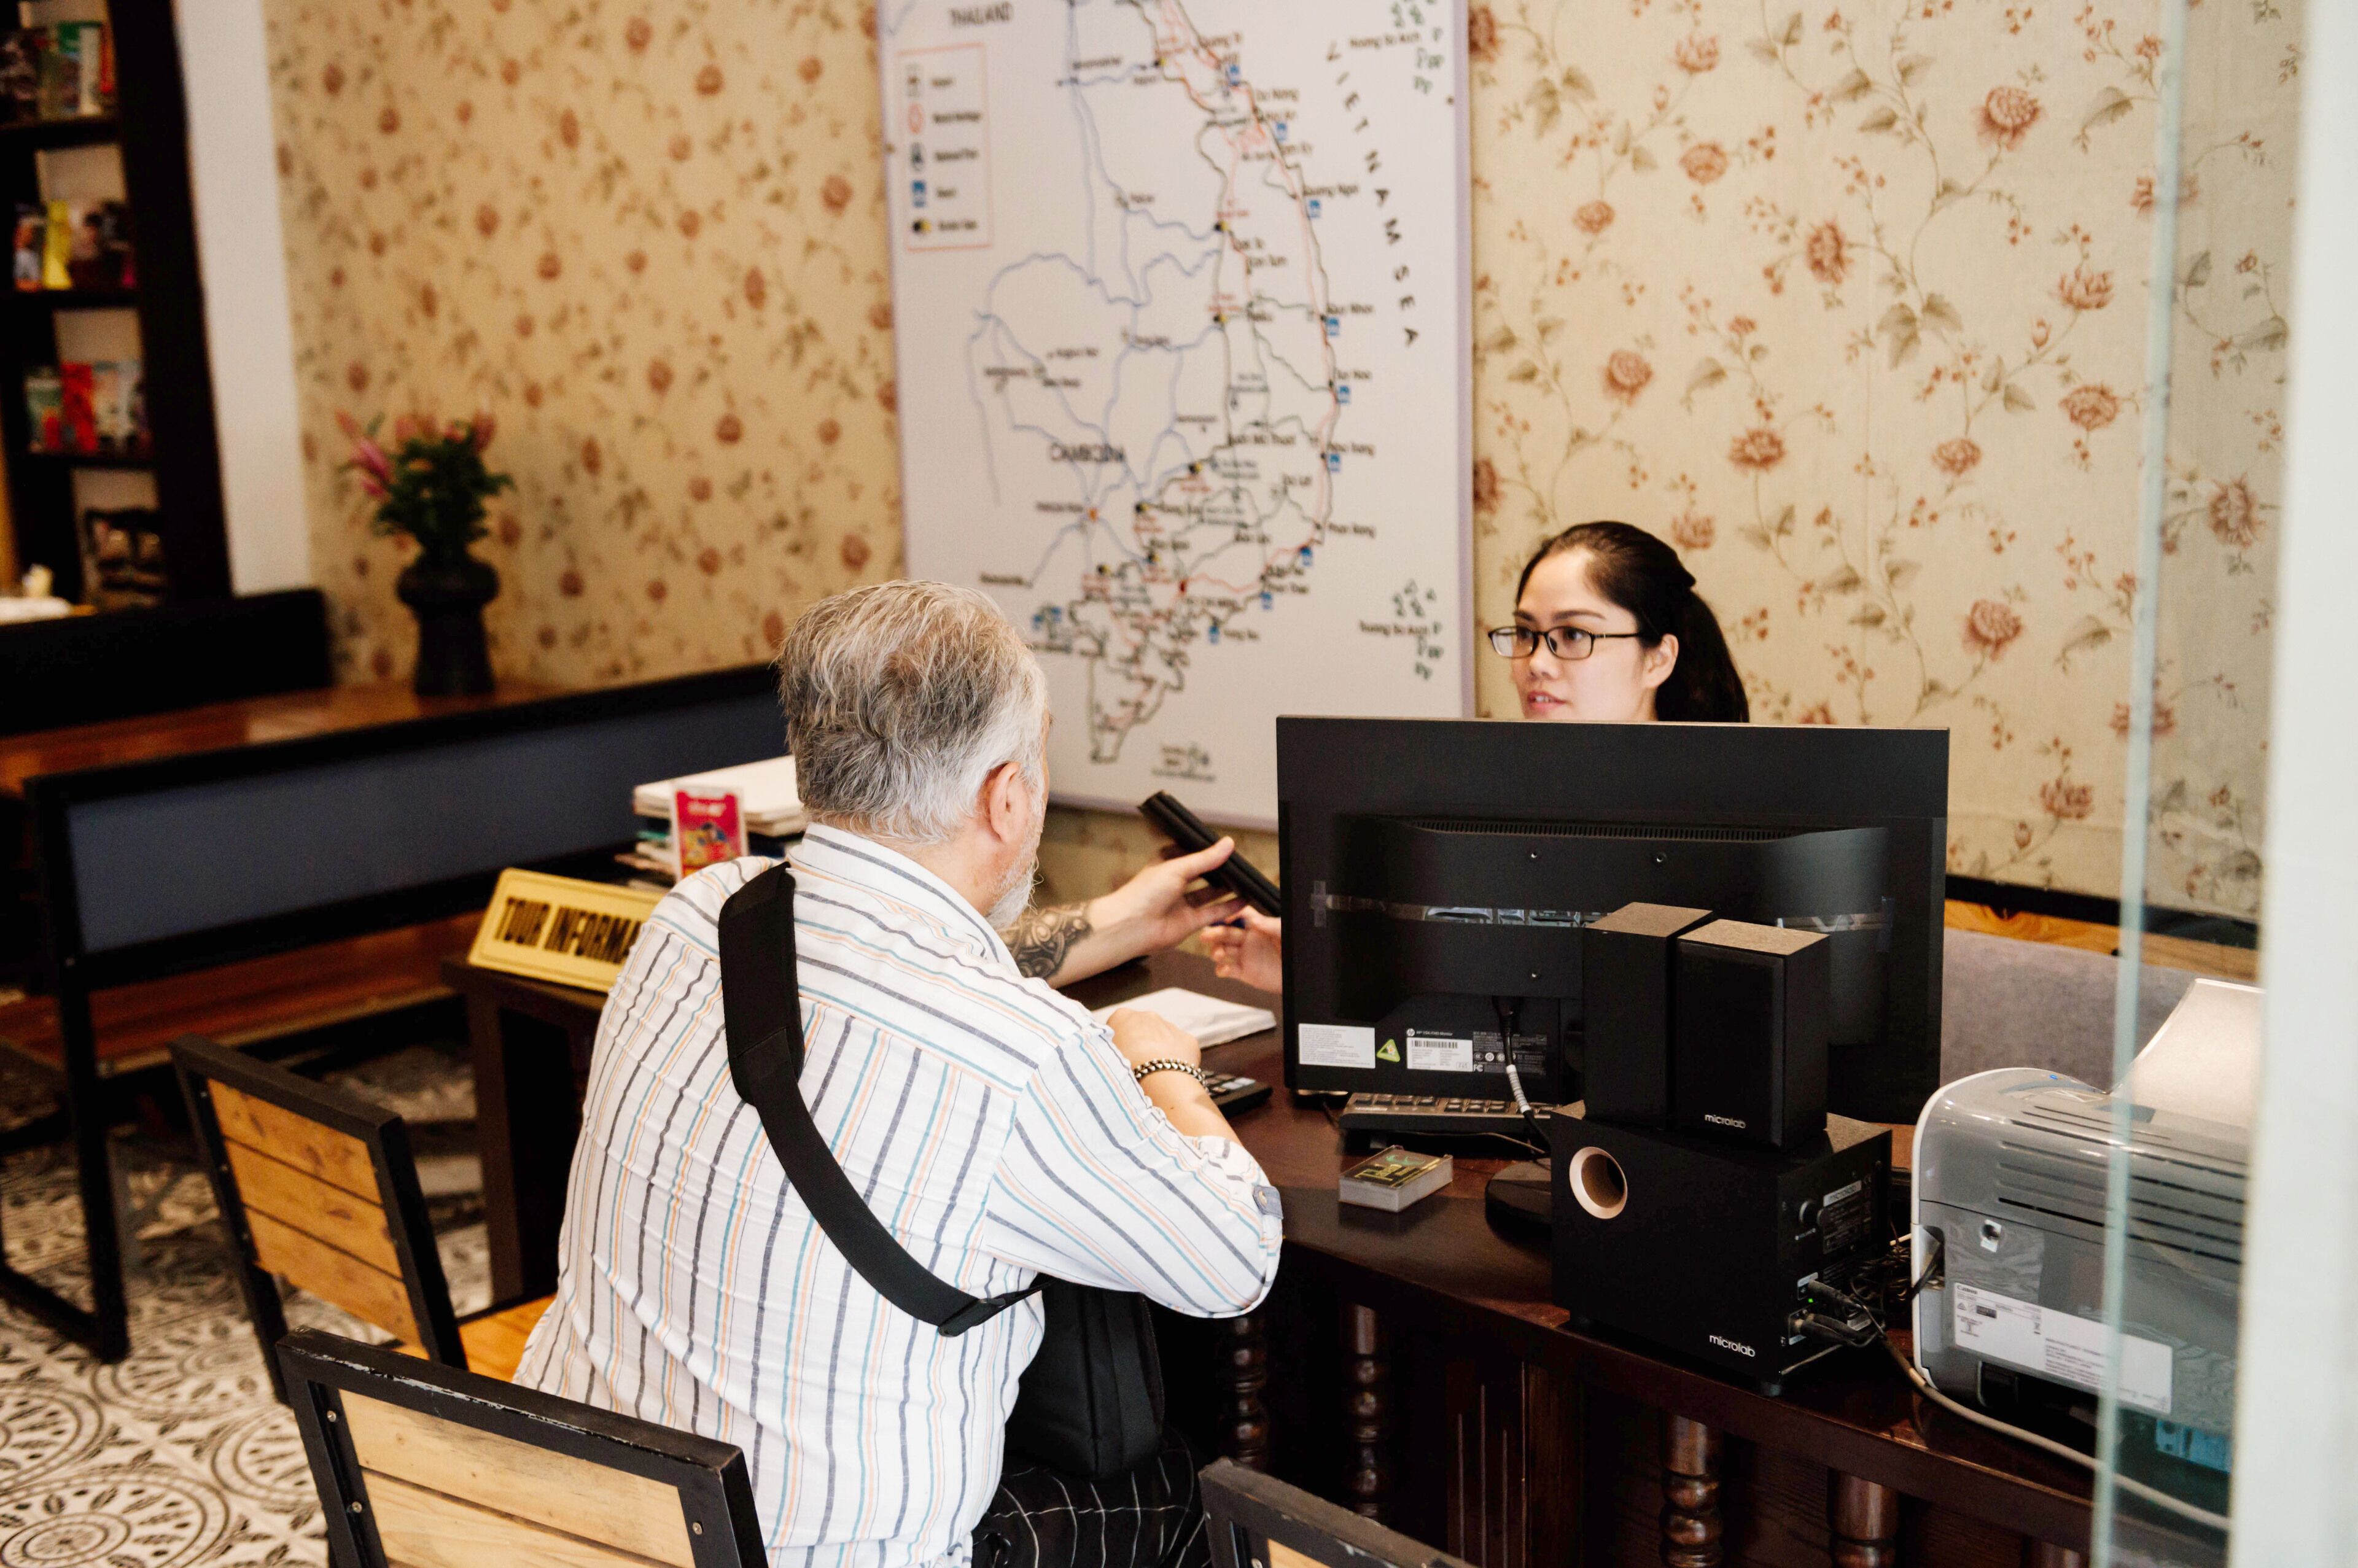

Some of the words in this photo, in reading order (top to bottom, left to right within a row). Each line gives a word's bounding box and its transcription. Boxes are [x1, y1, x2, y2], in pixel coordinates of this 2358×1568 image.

[949, 2, 1013, 26] THAILAND
[495, 897, 551, 947] TOUR
[1705, 1114, 1745, 1128] microlab
[1709, 1335, 1755, 1357] microlab
